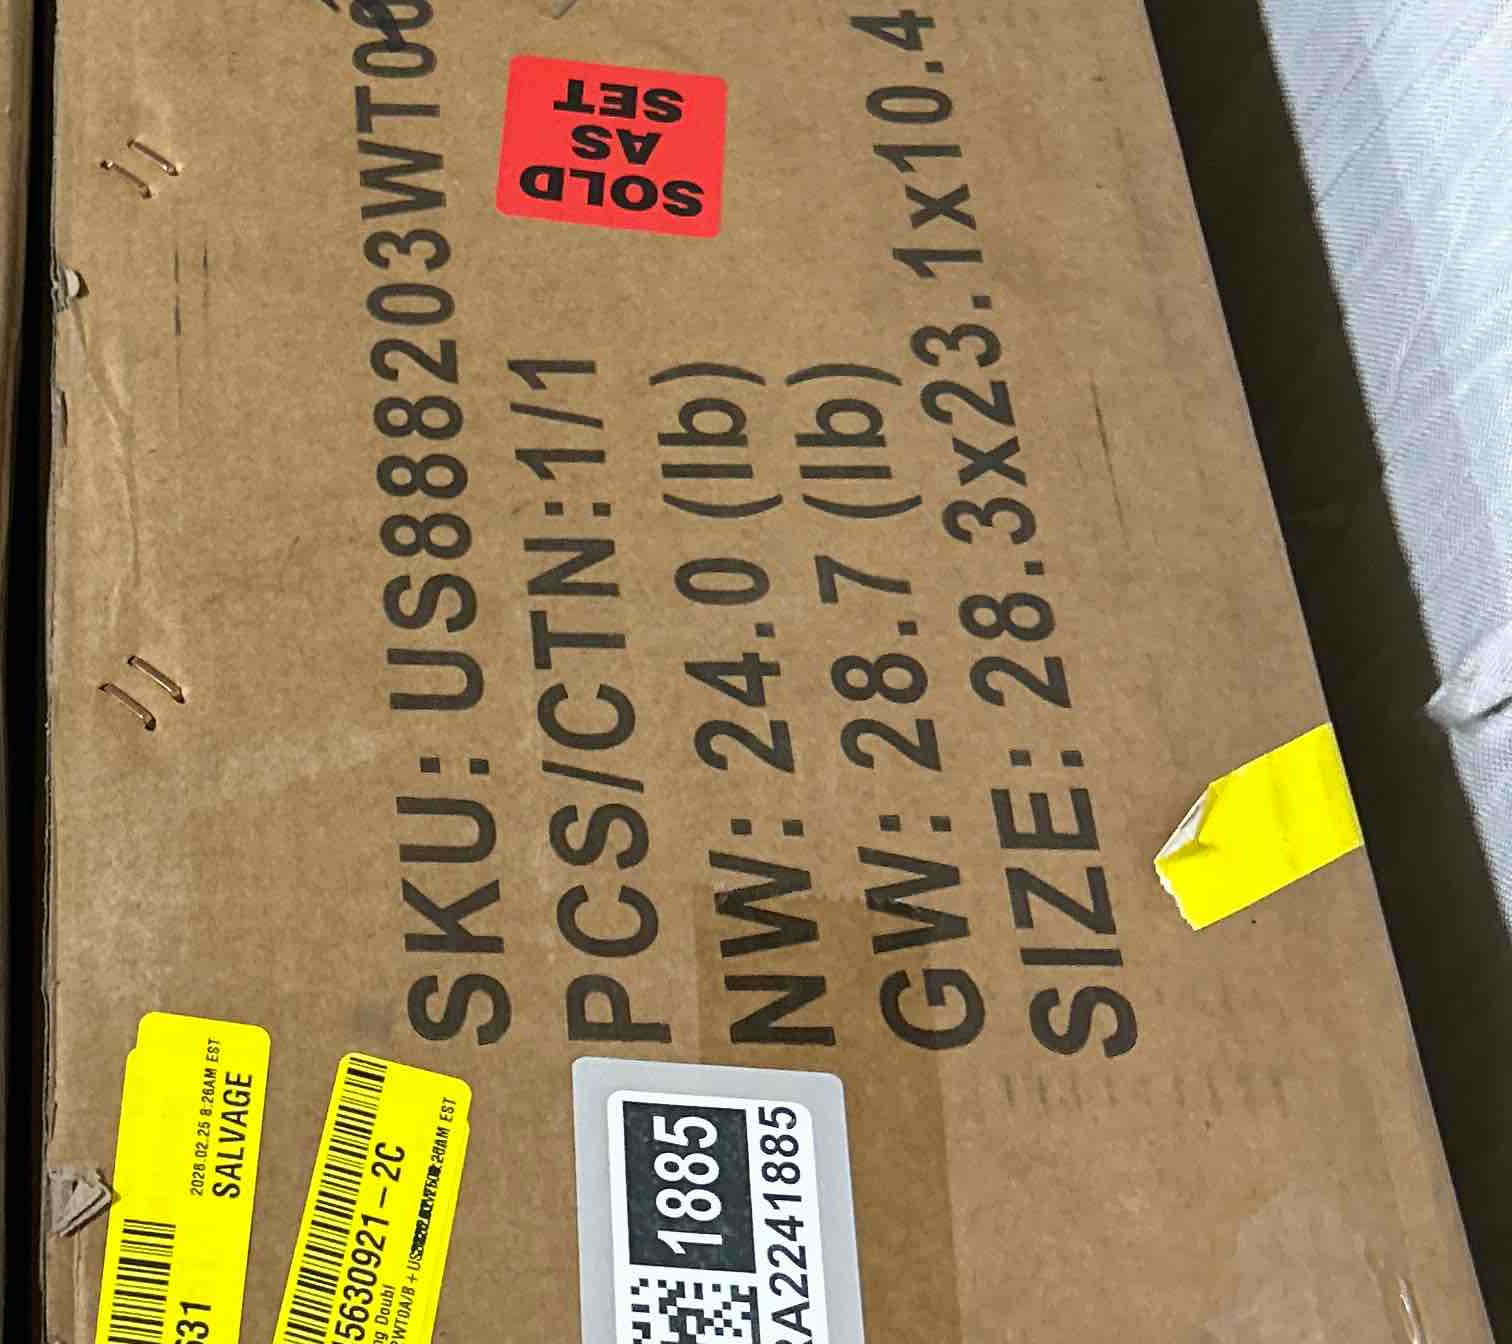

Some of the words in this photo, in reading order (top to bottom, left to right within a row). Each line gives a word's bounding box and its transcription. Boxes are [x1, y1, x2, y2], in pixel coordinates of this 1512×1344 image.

[552, 78, 685, 124] SET
[570, 123, 663, 166] AS
[519, 164, 705, 218] SOLD
[507, 358, 672, 1044] PCS/CTN:1/1
[395, 754, 513, 1047] SKU:
[708, 816, 837, 1047] NW:
[857, 813, 986, 1052] GW:
[990, 748, 1139, 1058] SIZE:
[205, 1038, 223, 1063] EST
[438, 1096, 457, 1124] EST
[211, 1070, 254, 1200] SALVAGE
[651, 1114, 724, 1257] 1885
[375, 1284, 396, 1326] Doubl
